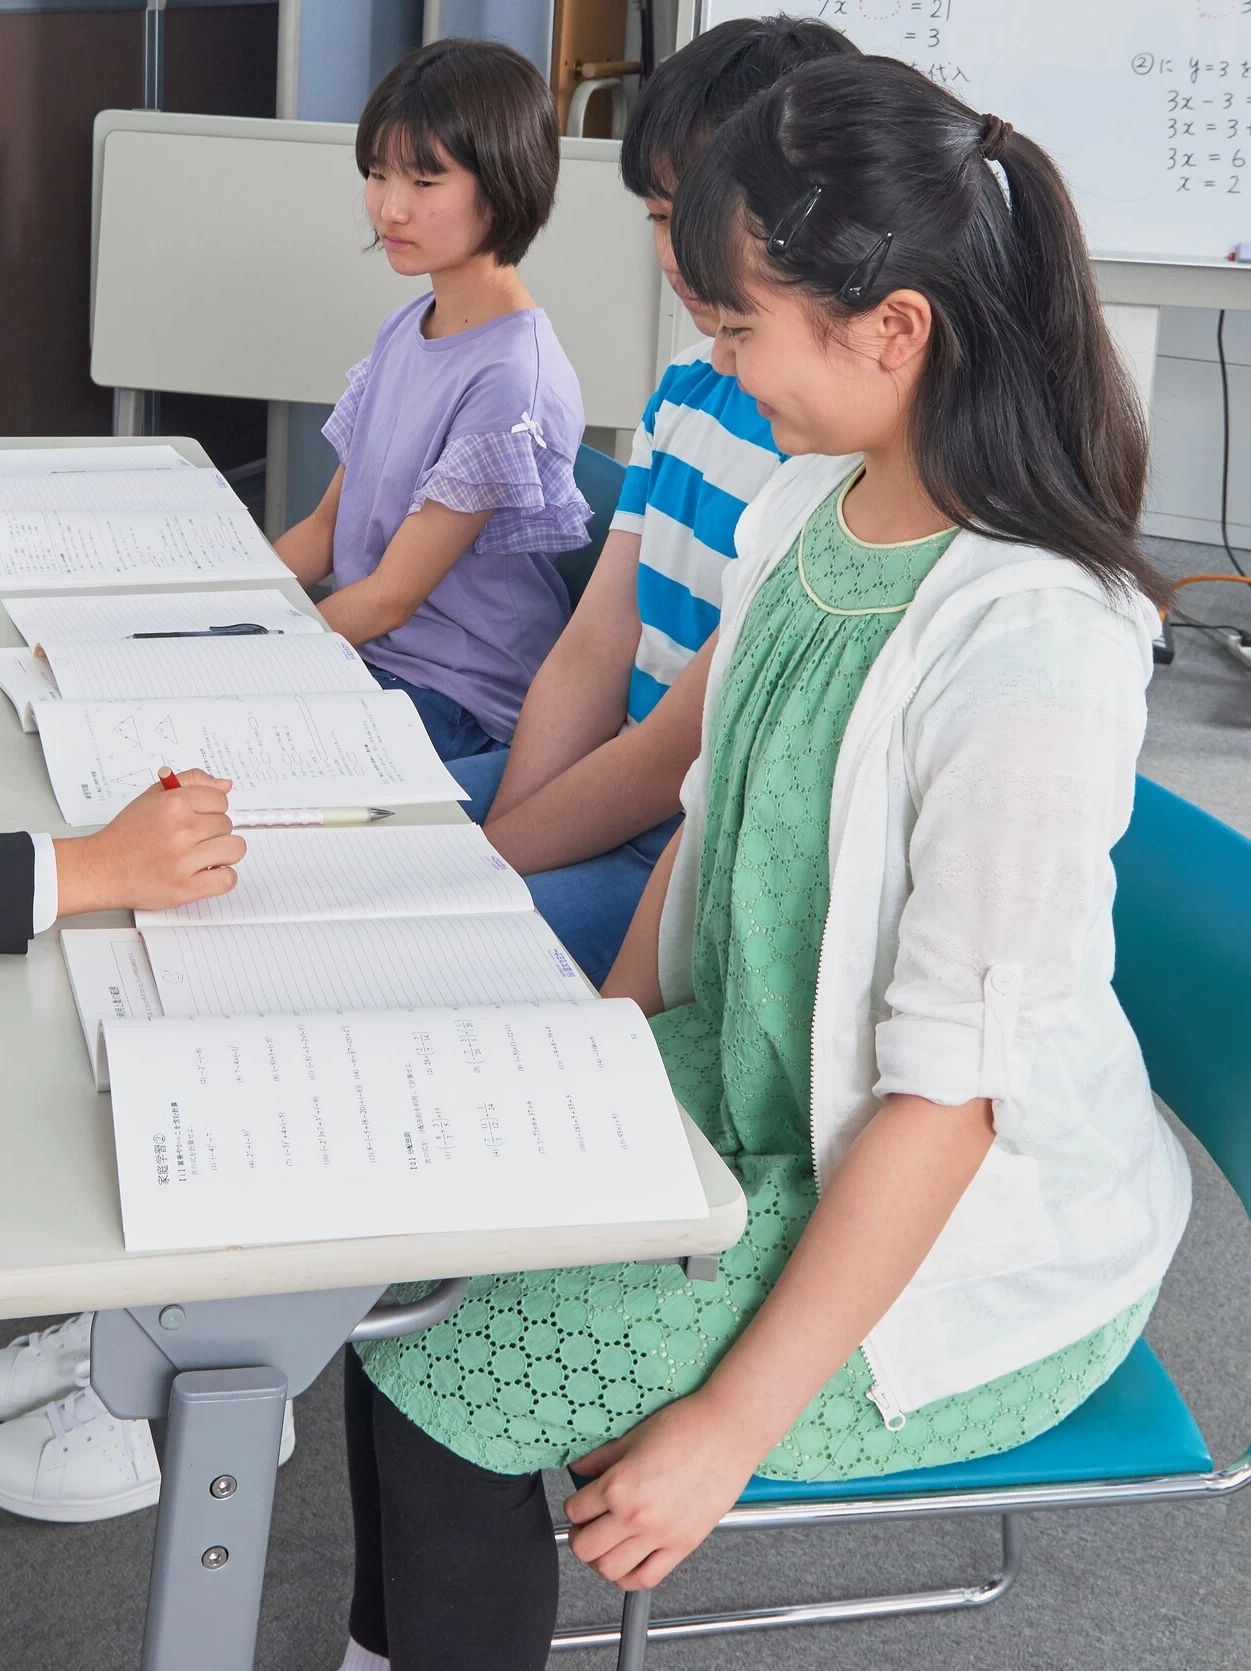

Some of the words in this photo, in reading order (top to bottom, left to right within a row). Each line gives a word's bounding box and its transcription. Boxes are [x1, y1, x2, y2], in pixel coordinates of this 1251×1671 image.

[927, 28, 940, 47] 3
[1232, 148, 1246, 168] 6
[1227, 175, 1241, 194] 2
